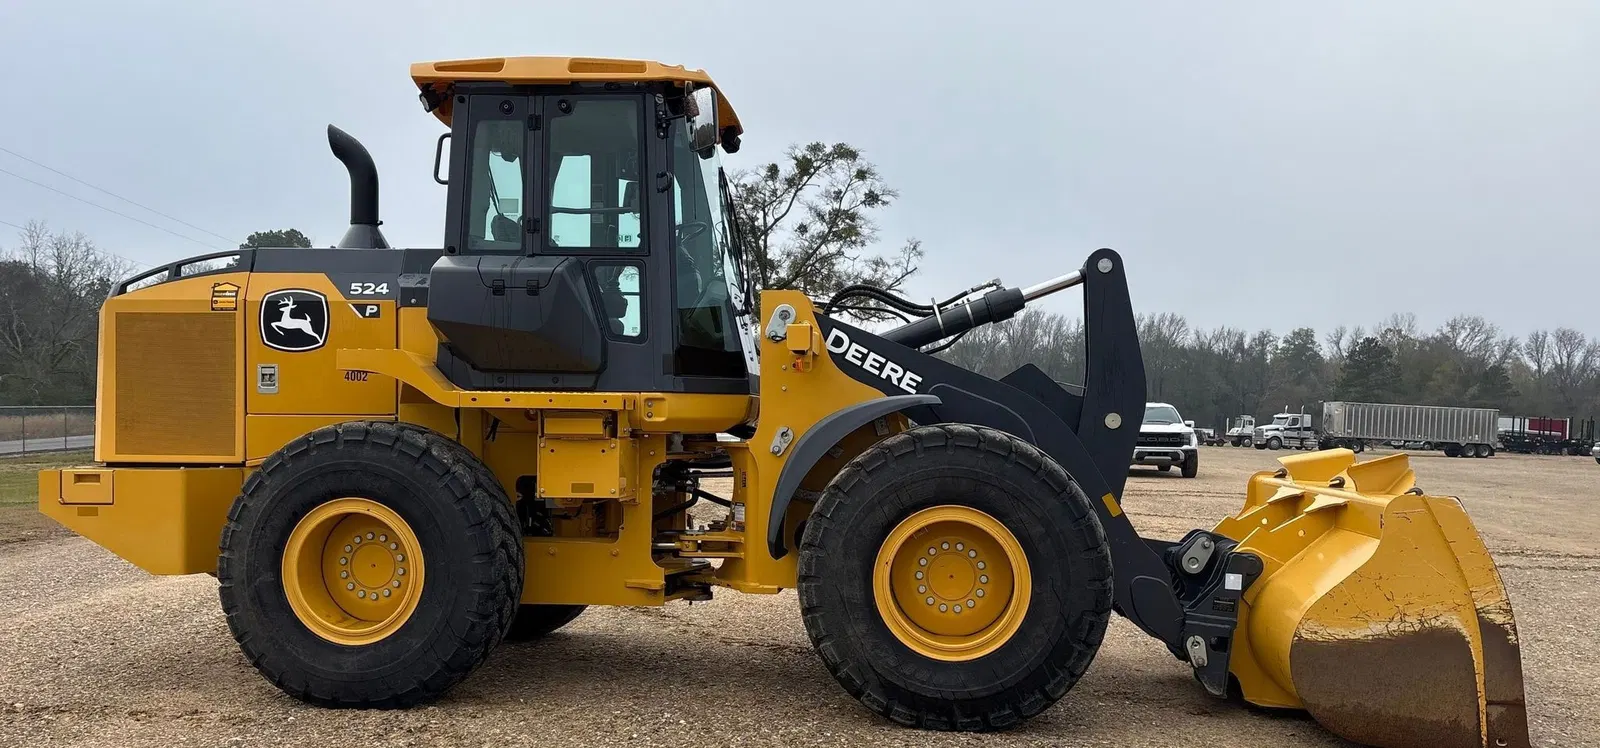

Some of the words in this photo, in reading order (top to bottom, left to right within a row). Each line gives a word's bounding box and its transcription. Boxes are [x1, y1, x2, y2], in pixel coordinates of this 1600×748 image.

[350, 282, 389, 295] 524
[365, 305, 378, 316] P
[825, 327, 923, 394] DEERE
[344, 371, 368, 382] 4002
